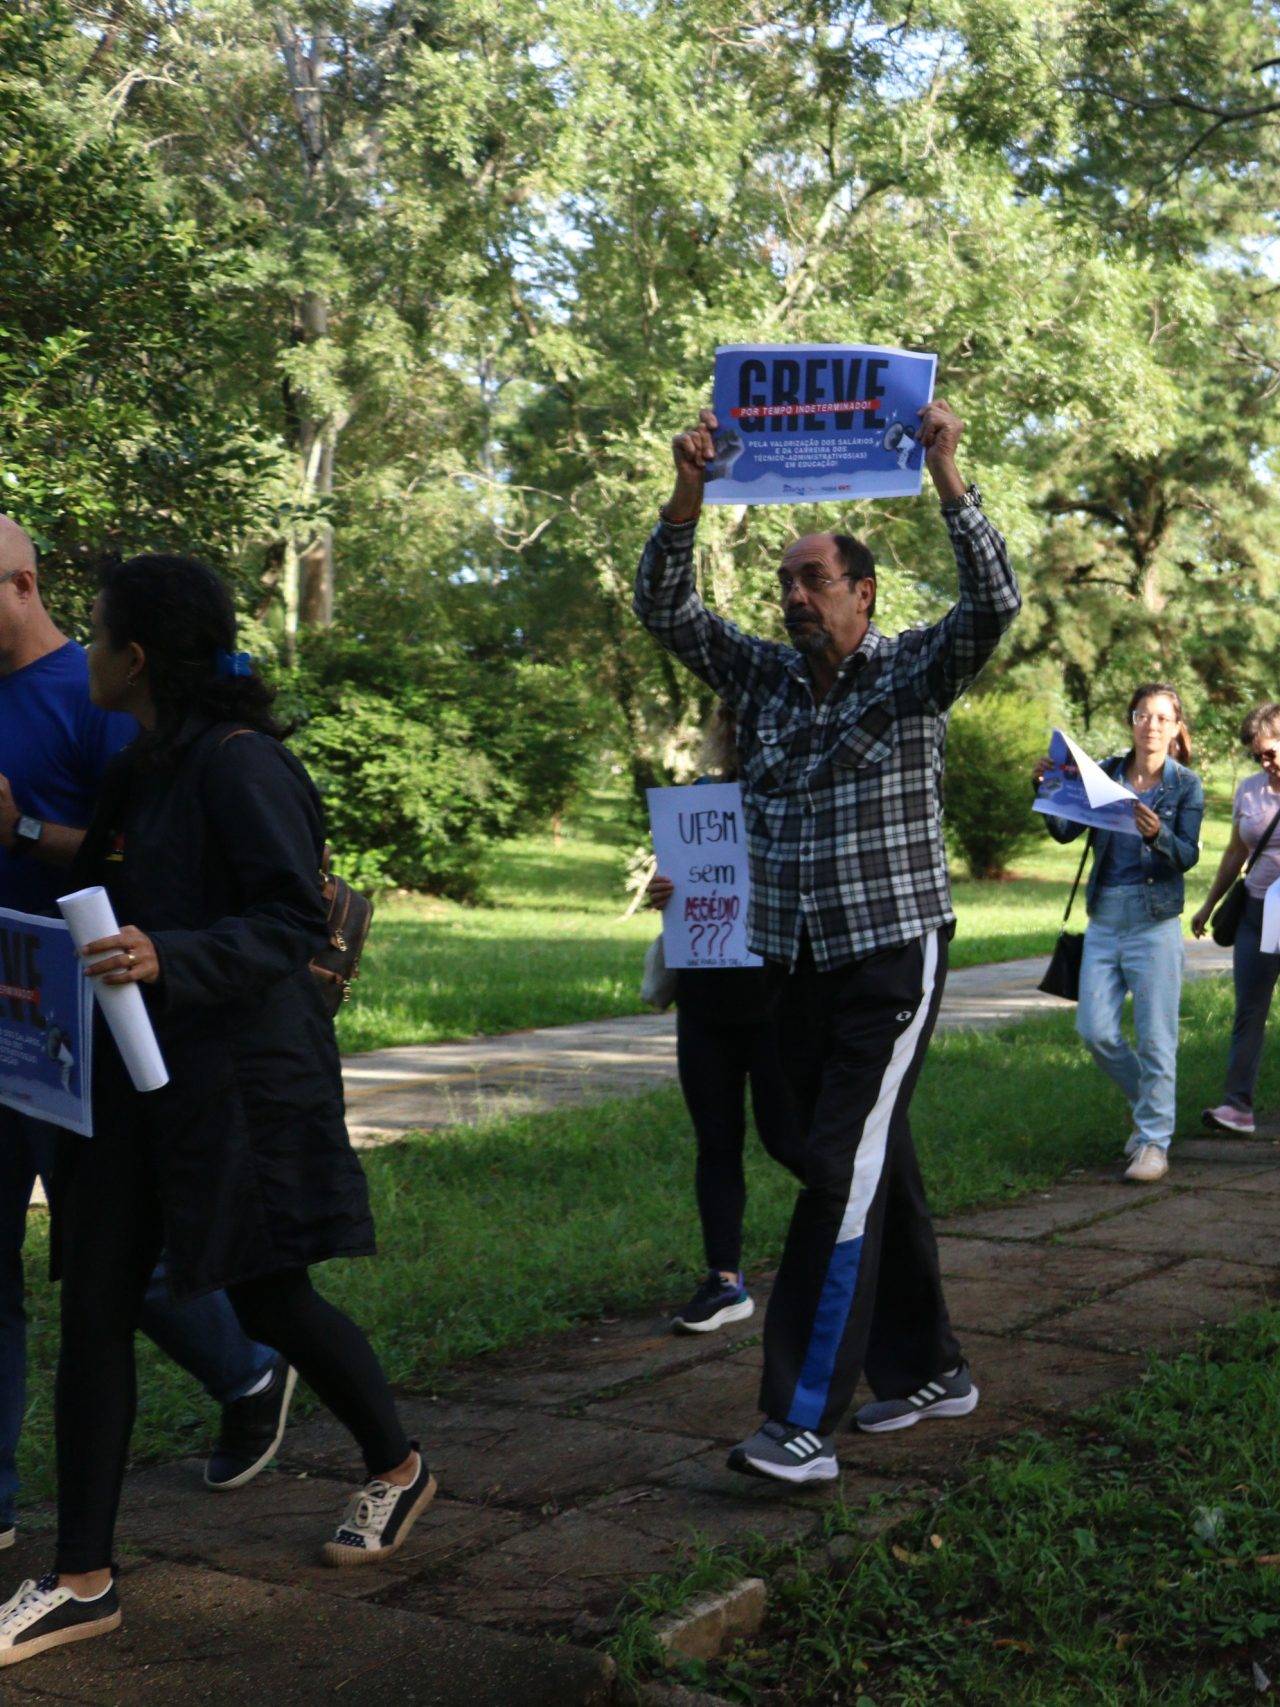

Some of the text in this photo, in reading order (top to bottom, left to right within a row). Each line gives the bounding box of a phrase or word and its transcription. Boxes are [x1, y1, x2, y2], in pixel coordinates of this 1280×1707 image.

[739, 359, 889, 432] GREVE
[740, 401, 872, 417] POR TEMPO INDETERMINADO!
[678, 809, 738, 845] UFSM
[688, 864, 735, 885] sem
[684, 889, 740, 922] ASSÉDIO
[688, 922, 733, 958] ???
